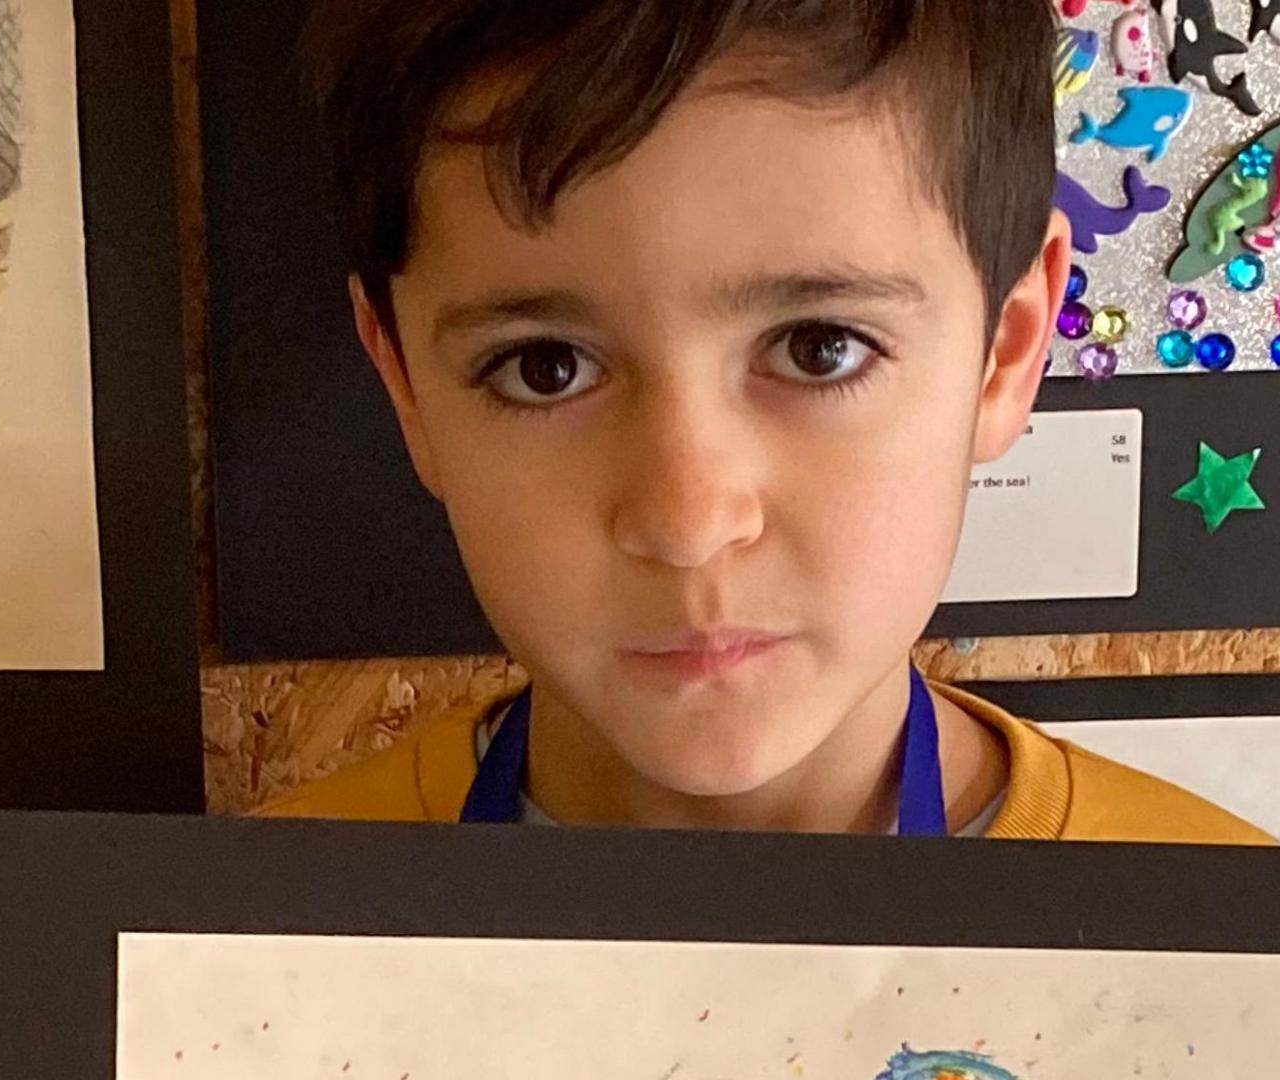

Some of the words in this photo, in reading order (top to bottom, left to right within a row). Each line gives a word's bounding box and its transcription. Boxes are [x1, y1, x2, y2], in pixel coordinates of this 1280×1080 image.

[1111, 452, 1130, 464] Yes
[983, 477, 1003, 488] the
[1006, 475, 1031, 488] sea!
